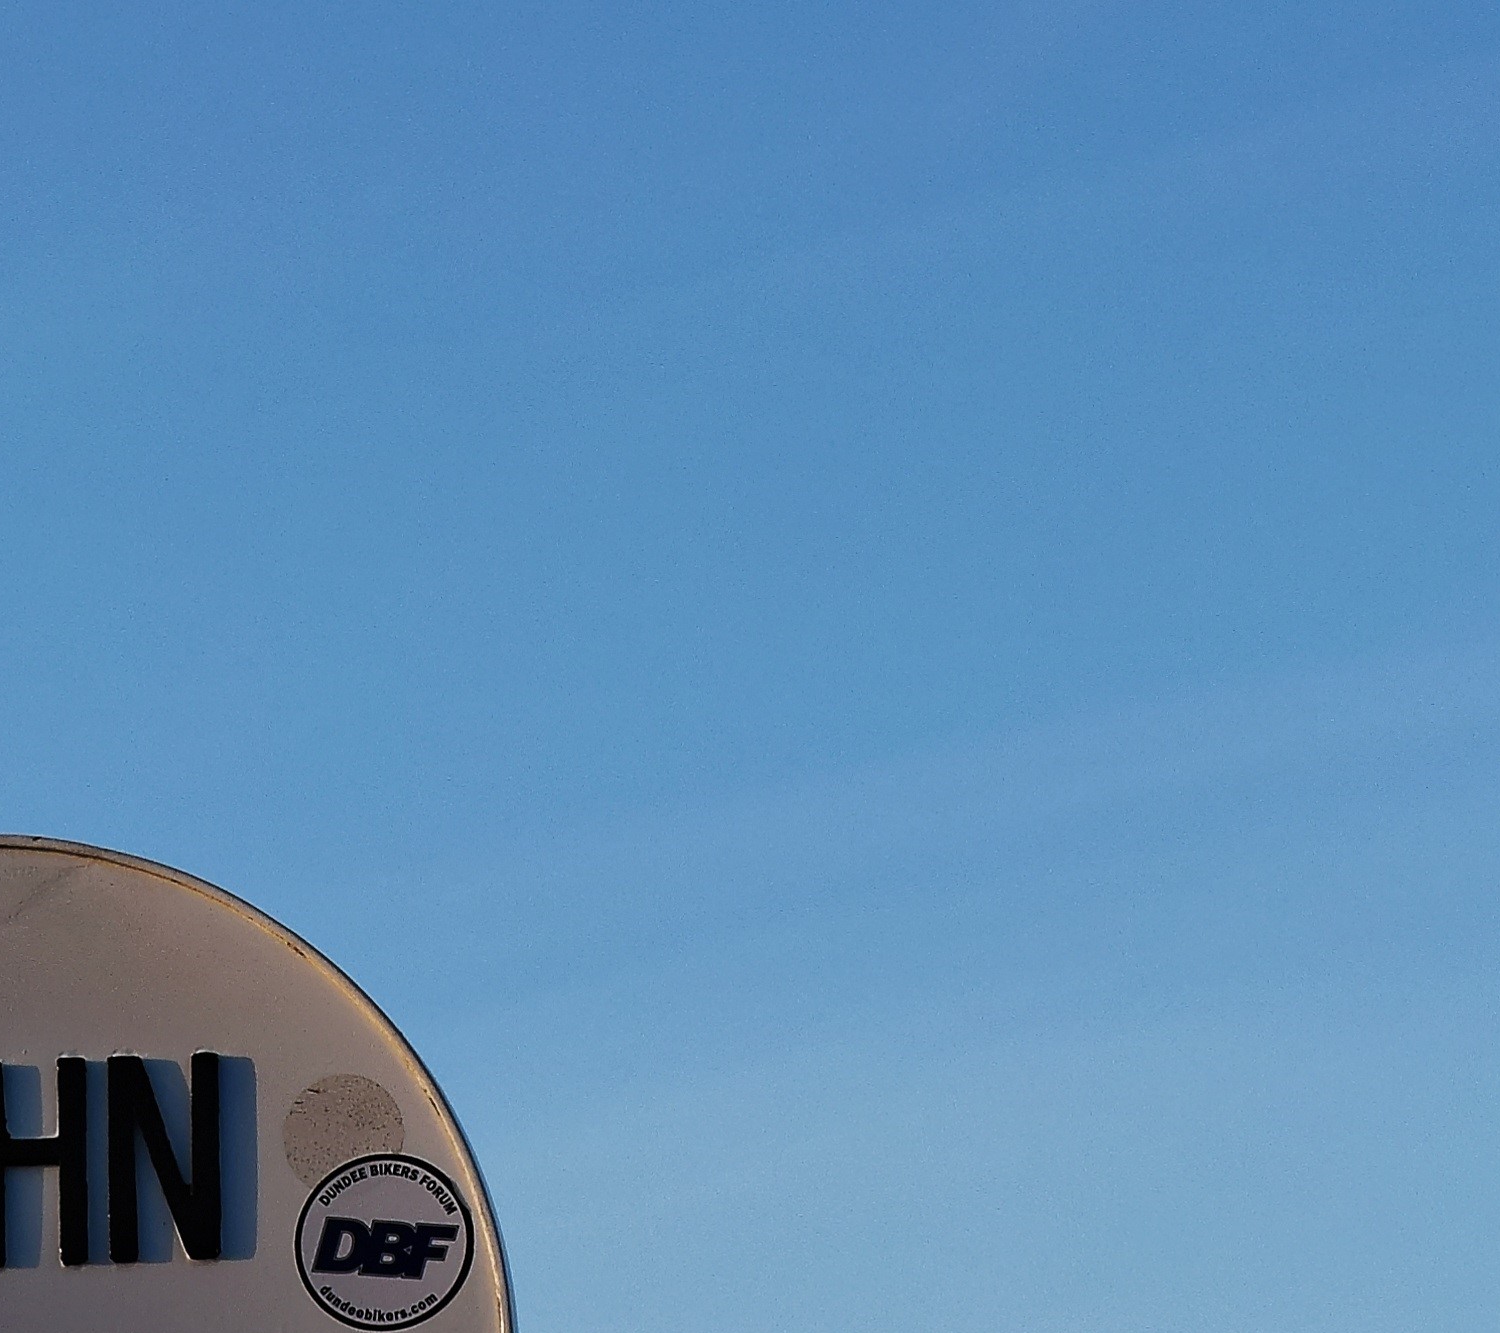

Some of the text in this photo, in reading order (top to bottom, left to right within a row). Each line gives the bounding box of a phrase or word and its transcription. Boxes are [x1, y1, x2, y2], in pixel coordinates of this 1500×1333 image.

[318, 1163, 458, 1215] DUNDEE BIKERS FORUM
[311, 1216, 460, 1280] DBF
[320, 1285, 438, 1322] dundeebikers.com
